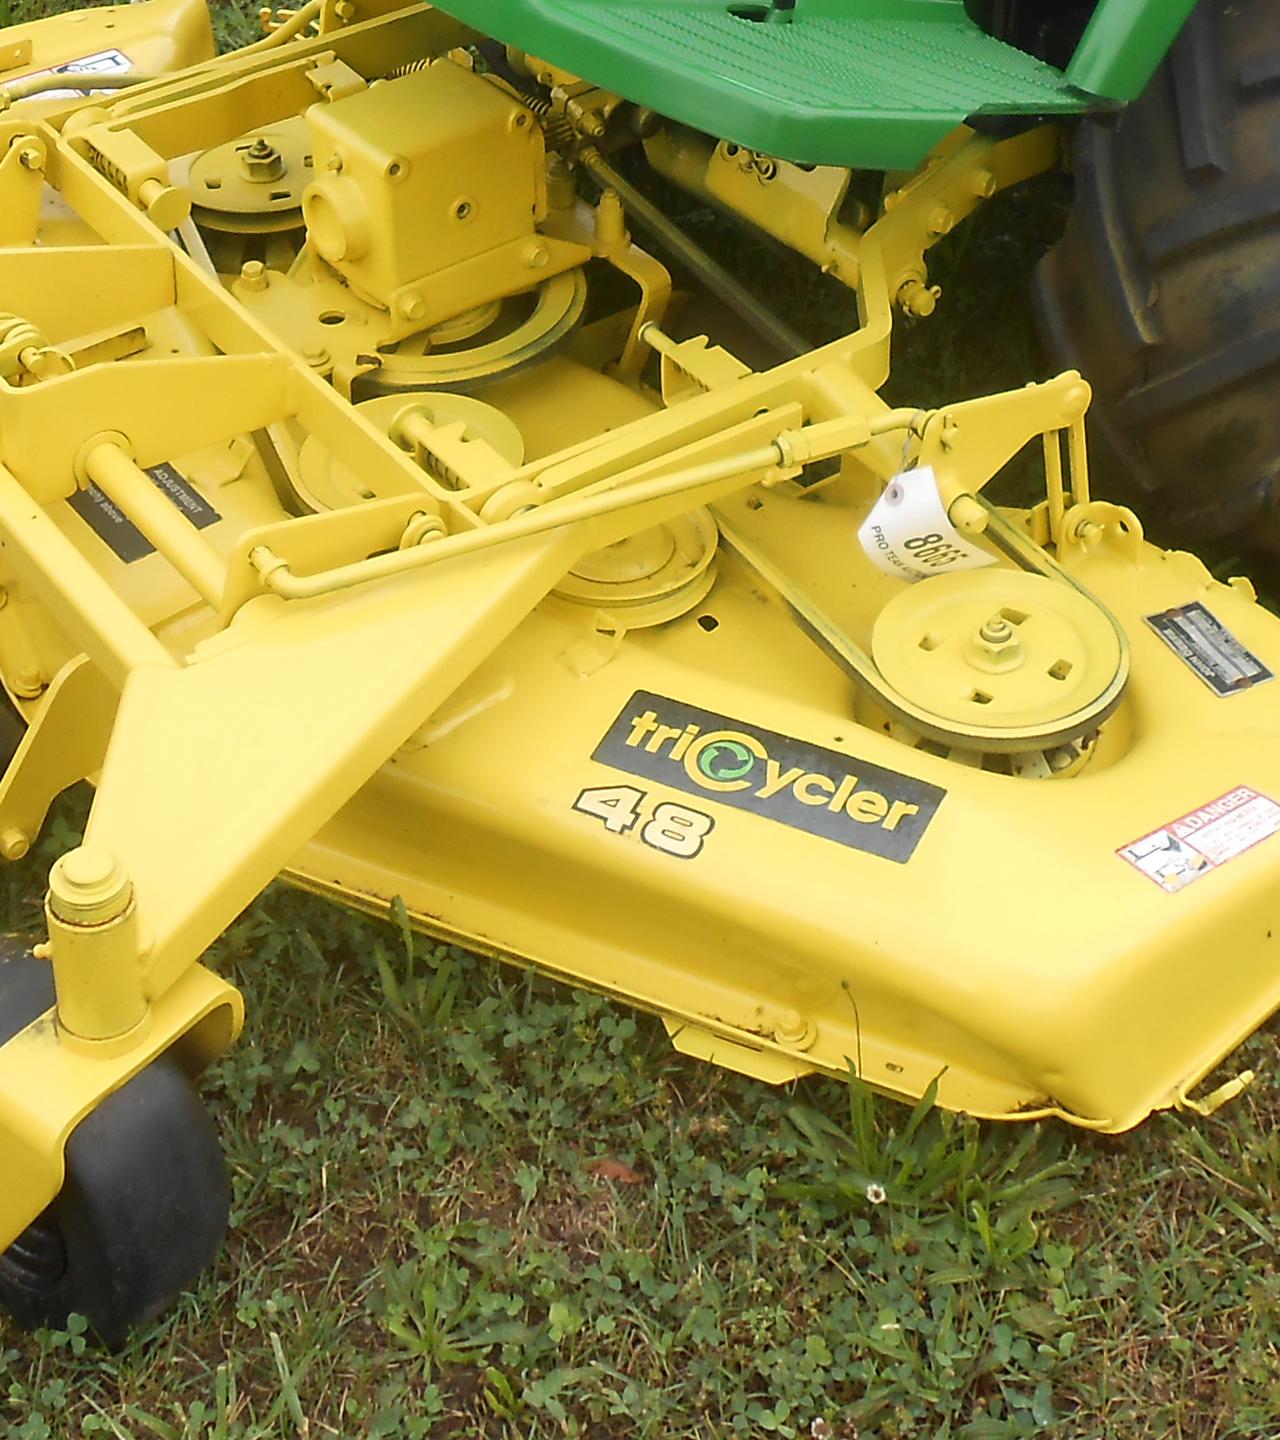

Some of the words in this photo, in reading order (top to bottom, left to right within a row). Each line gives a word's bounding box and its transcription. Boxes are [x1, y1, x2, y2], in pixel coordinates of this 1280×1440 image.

[153, 469, 203, 514] ADJUSTMENT
[871, 525, 889, 550] PRO
[571, 784, 716, 860] 48
[1186, 789, 1257, 829] DANGER
